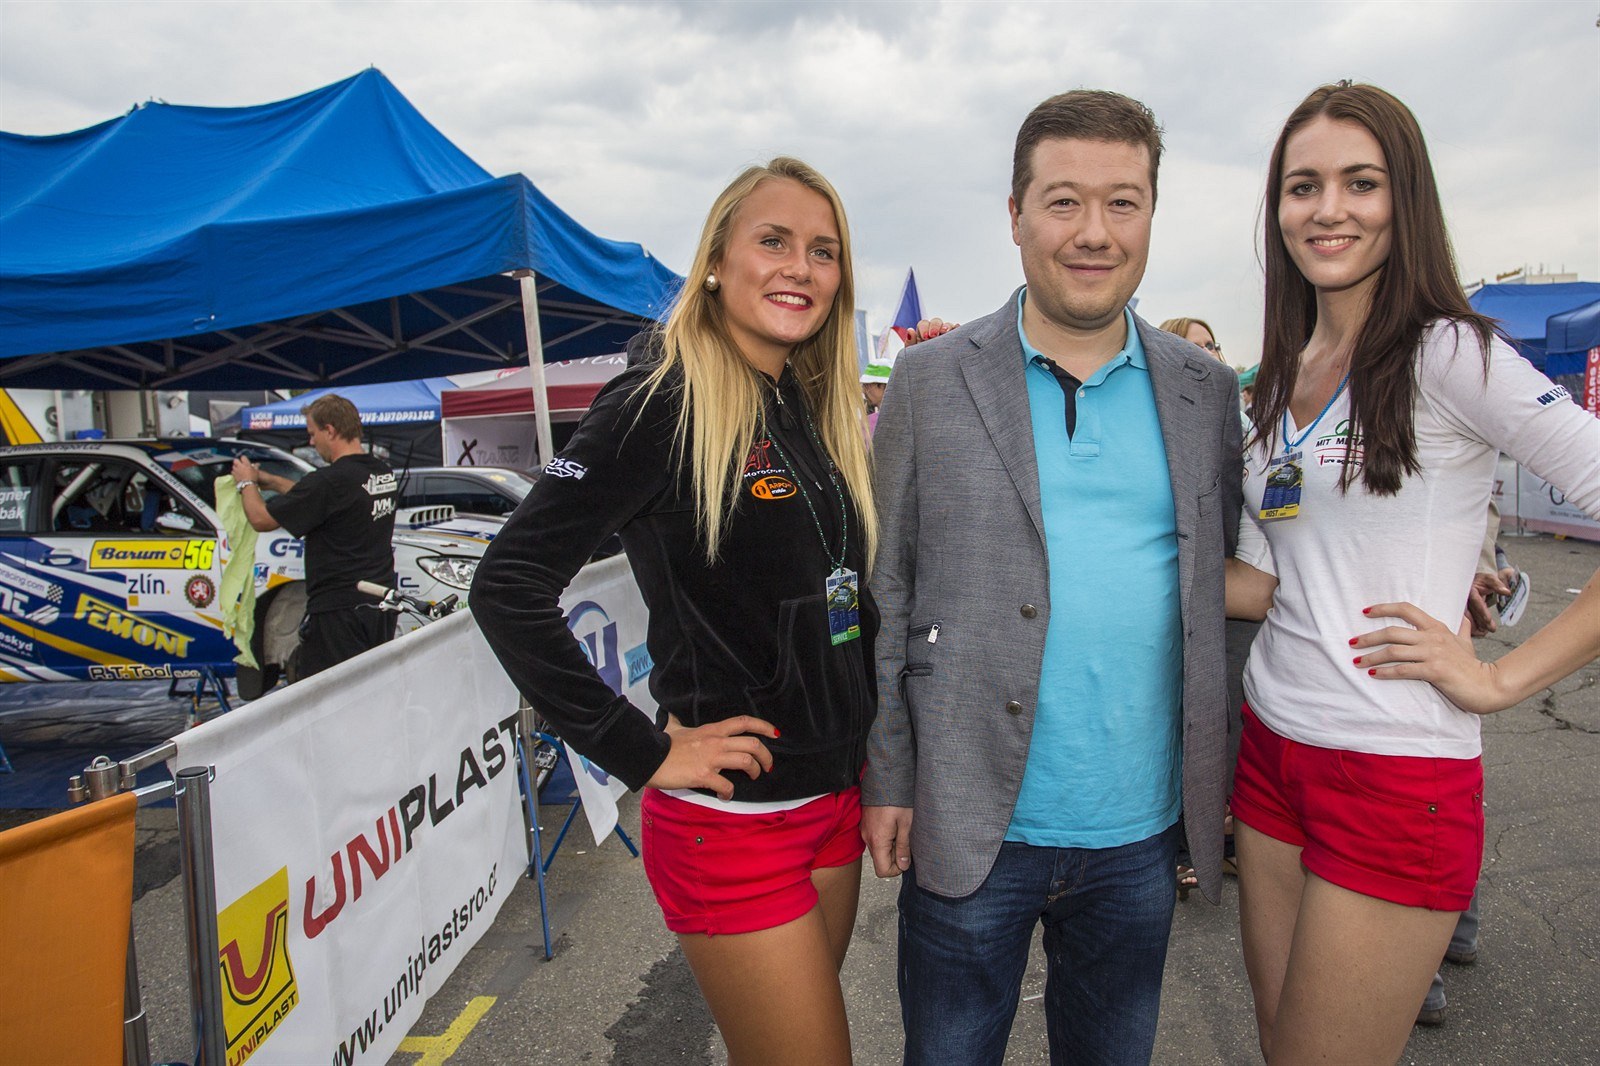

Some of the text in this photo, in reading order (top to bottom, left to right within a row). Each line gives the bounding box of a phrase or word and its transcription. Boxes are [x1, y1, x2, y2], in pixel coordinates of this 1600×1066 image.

[1315, 438, 1332, 448] MIT
[97, 540, 216, 570] Barum 56
[130, 663, 171, 680] Tool
[303, 710, 520, 939] UNIPLAST
[228, 990, 297, 1066] UNIPLAST
